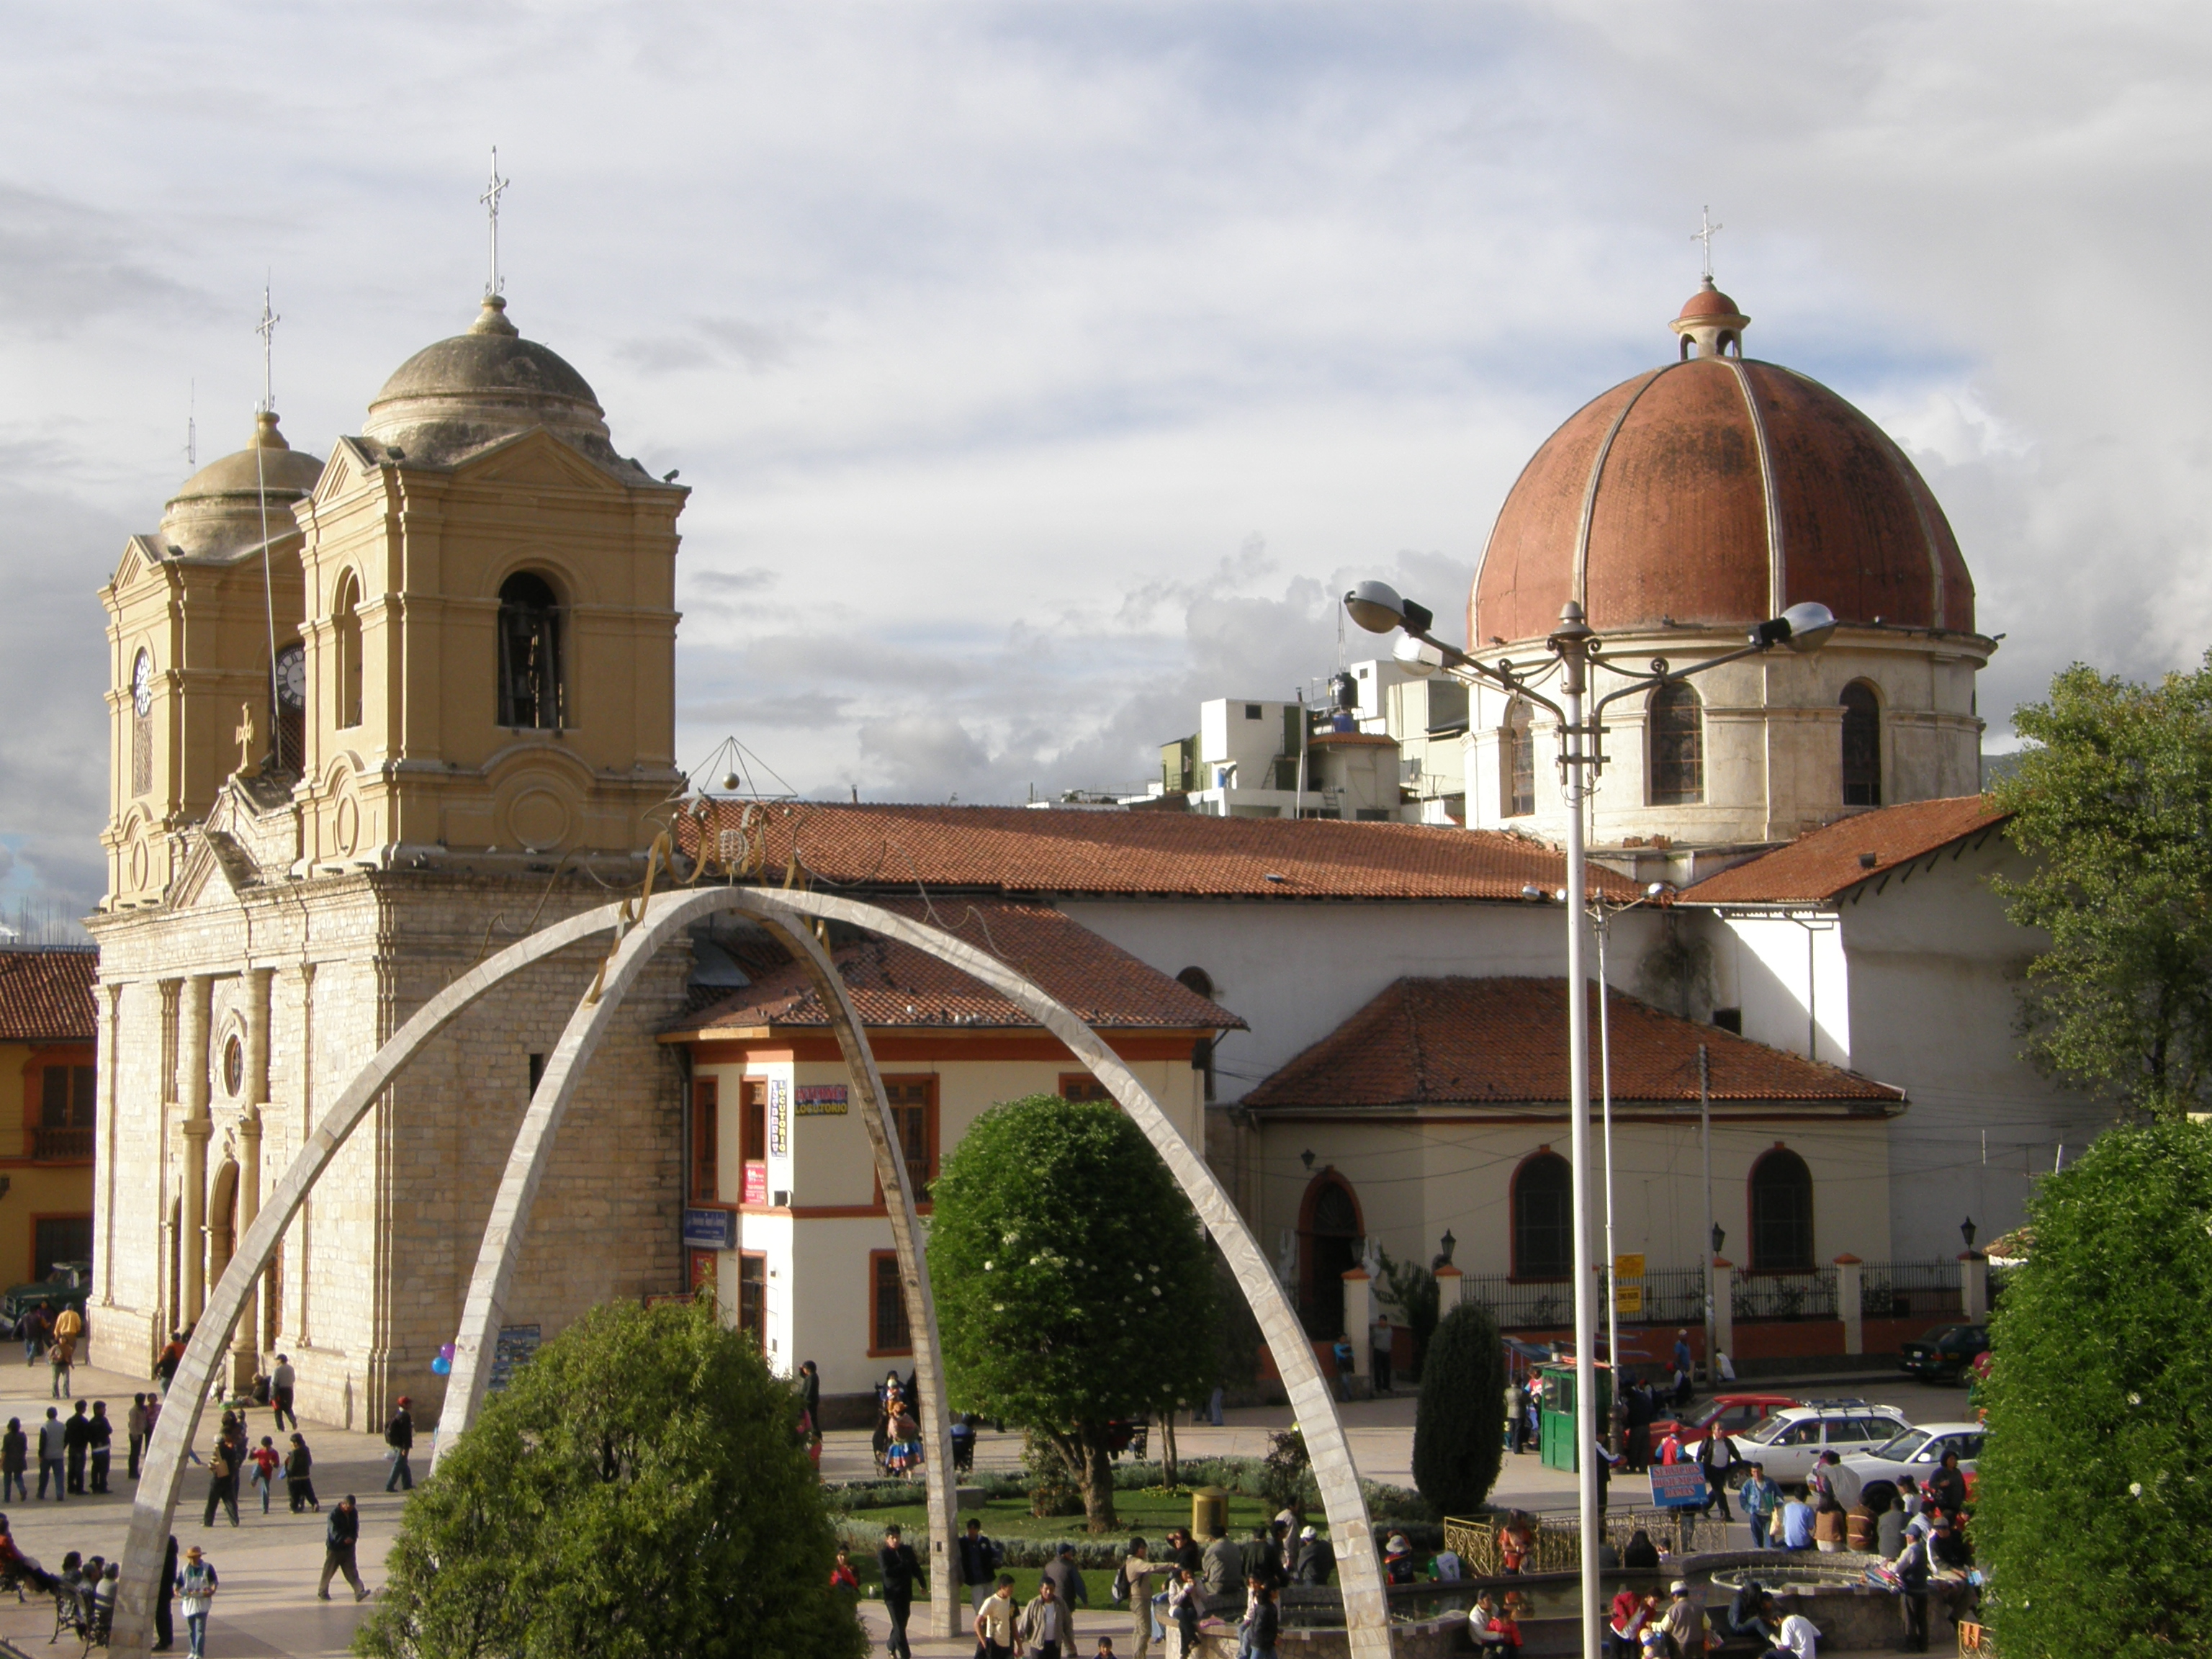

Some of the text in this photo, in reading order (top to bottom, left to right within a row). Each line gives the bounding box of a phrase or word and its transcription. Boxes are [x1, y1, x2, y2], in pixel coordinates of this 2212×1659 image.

[795, 1087, 846, 1101] INTERNET
[795, 1103, 847, 1114] LOCUTORIO
[1653, 1464, 1701, 1478] SERVICIOS
[1652, 1475, 1705, 1489] HIGIENICOS
[1664, 1486, 1696, 1498] DAMAS
